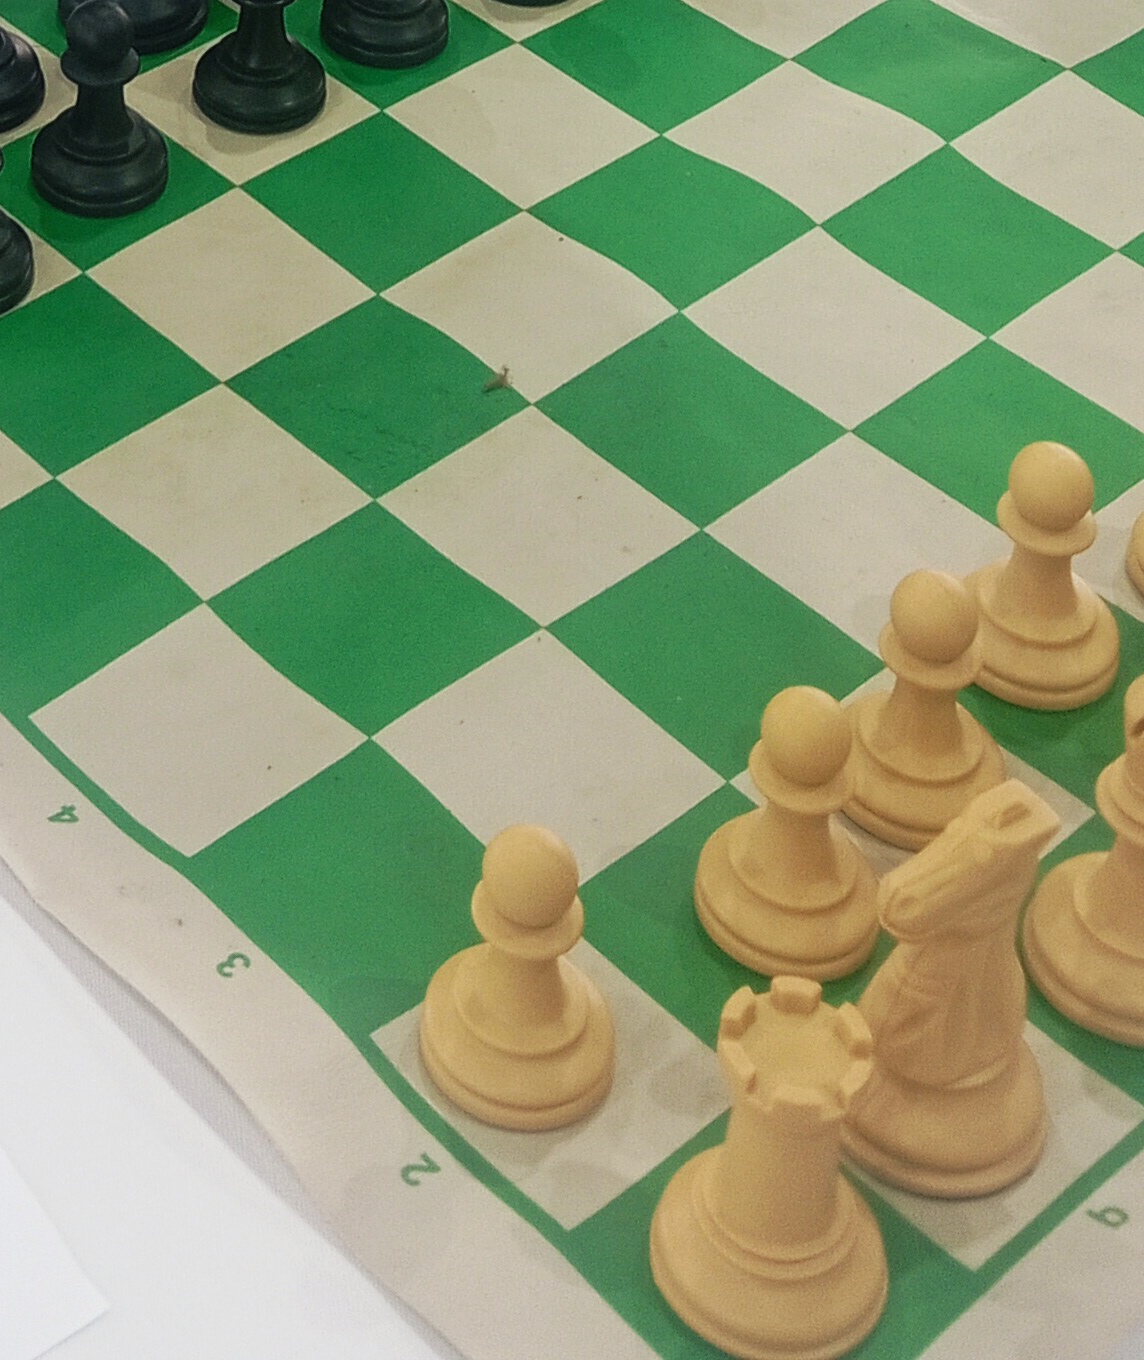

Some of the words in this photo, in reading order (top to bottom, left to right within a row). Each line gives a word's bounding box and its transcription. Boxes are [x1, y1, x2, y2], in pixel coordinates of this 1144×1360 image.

[47, 804, 80, 824] 4
[216, 952, 251, 978] 3
[400, 1152, 442, 1187] 2
